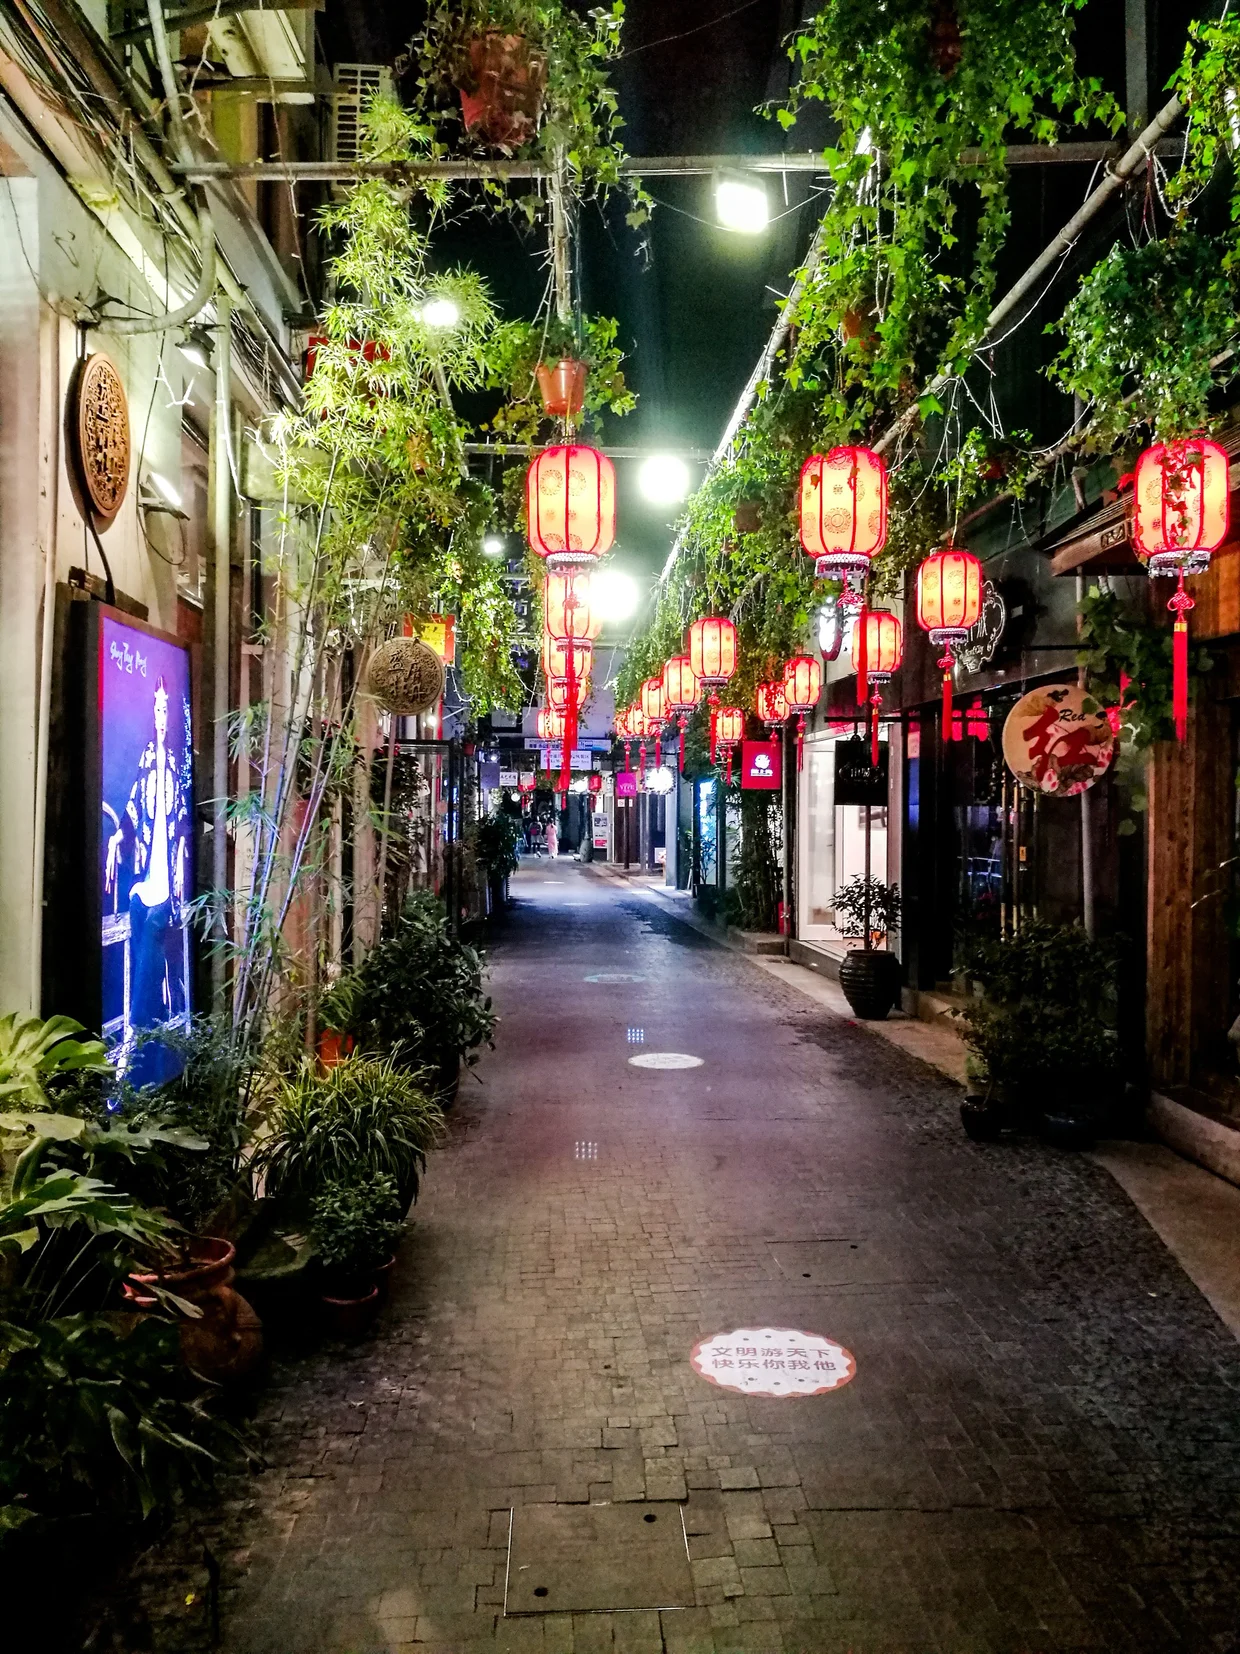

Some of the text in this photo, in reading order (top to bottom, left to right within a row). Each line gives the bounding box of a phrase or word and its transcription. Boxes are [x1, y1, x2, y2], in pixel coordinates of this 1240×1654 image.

[1059, 708, 1087, 722] Red
[1022, 705, 1099, 782] 红
[711, 1346, 832, 1359] 文明游天下
[711, 1358, 837, 1371] 快乐你我他
